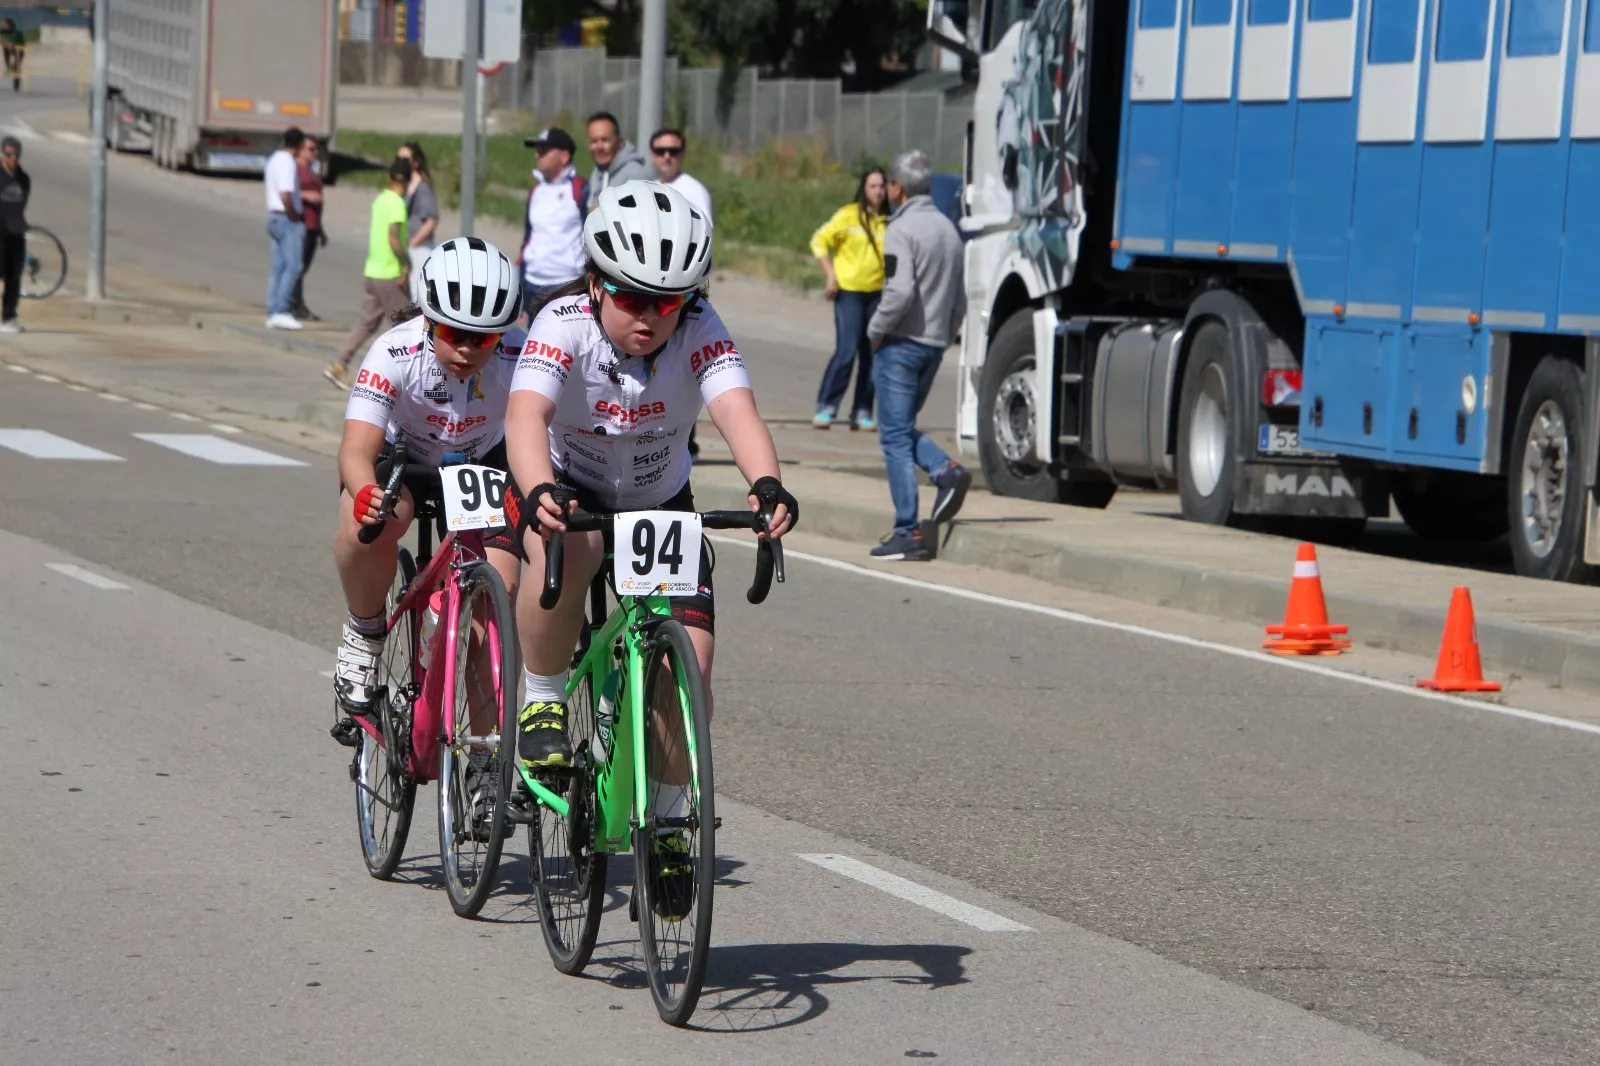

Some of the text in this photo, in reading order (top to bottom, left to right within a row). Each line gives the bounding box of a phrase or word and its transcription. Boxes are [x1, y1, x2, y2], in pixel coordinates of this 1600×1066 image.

[457, 468, 505, 512] 96
[1264, 473, 1360, 497] MAN
[631, 518, 683, 576] 94
